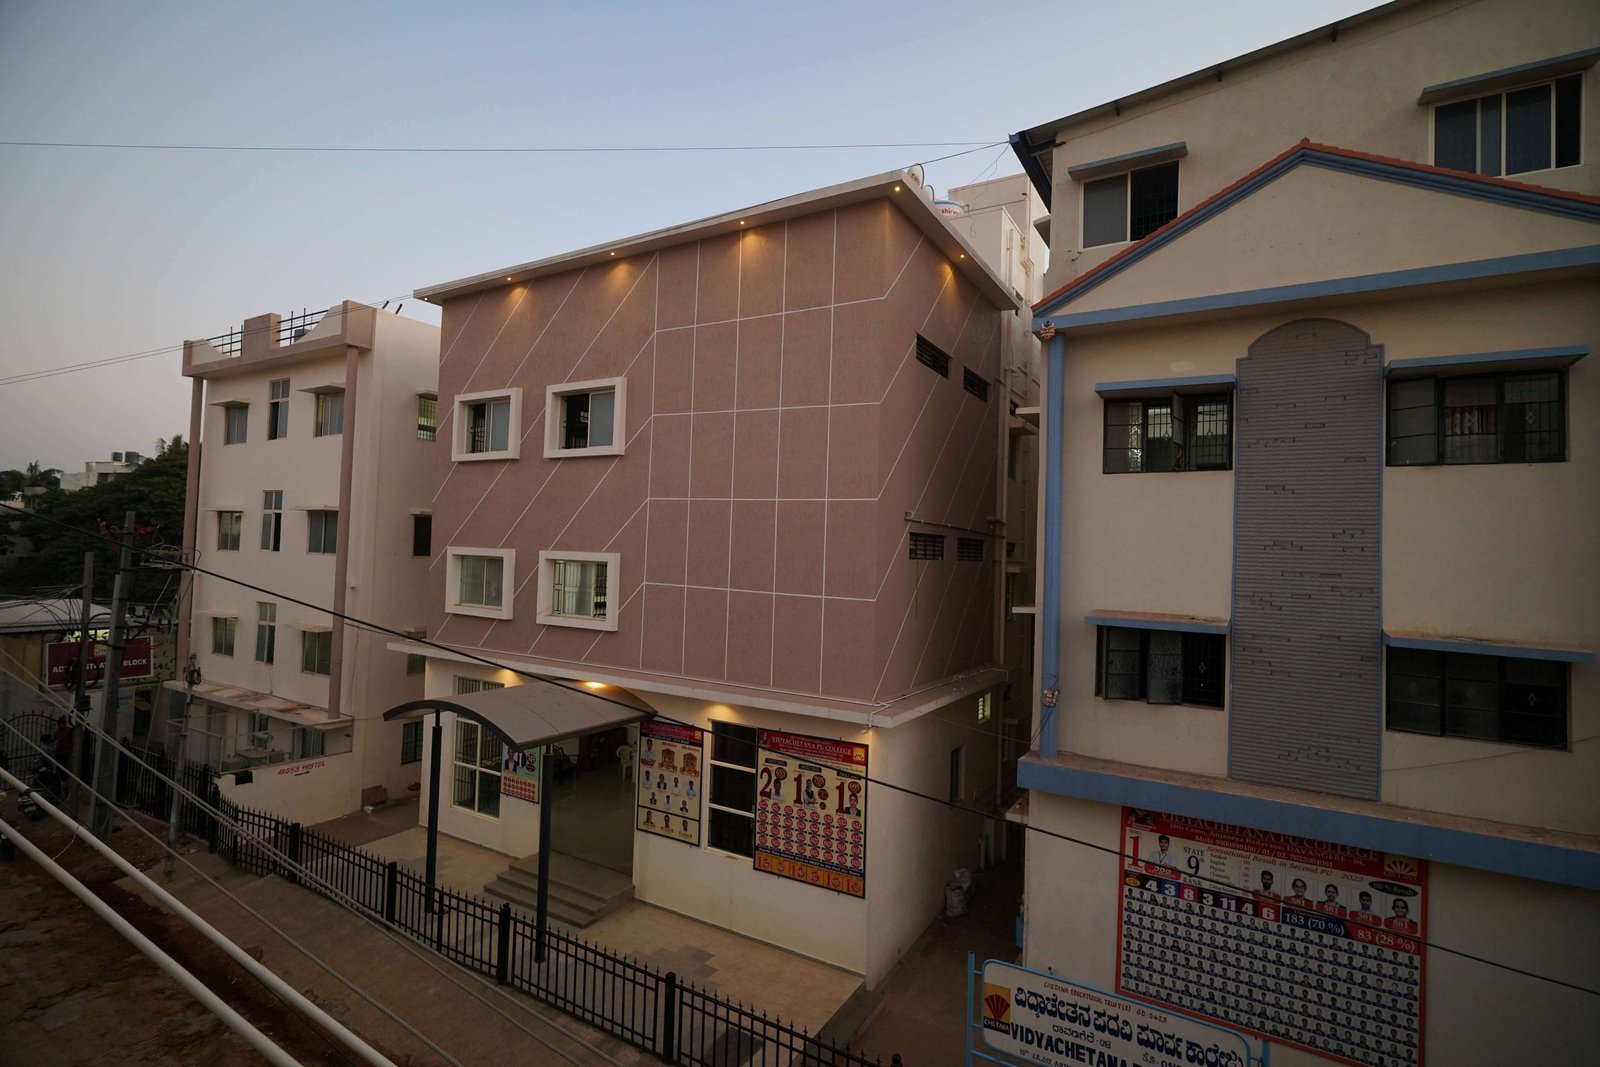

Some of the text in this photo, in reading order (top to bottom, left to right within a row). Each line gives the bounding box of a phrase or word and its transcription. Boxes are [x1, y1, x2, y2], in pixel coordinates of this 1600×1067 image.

[122, 658, 147, 667] BLOCK
[760, 767, 772, 799] 2
[793, 773, 803, 804] 1
[836, 782, 846, 814] 1
[1128, 835, 1142, 867] 1
[1183, 846, 1204, 857] STATE
[1206, 846, 1251, 860] Sensational
[1252, 854, 1277, 866] Result
[1288, 861, 1318, 874] Second
[1145, 879, 1158, 892] 4
[1164, 883, 1176, 896] 3
[1183, 888, 1194, 901] 8
[1202, 893, 1213, 905] 3
[1220, 897, 1236, 911] 11
[1242, 902, 1253, 915] 4
[1262, 907, 1275, 920] 6
[1284, 912, 1304, 925] 183
[1392, 920, 1408, 929] 581
[1357, 929, 1372, 940] 83
[1044, 981, 1069, 994] CHETANA
[984, 1017, 1010, 1033] CHETANA
[1014, 986, 1091, 1028] ವಿದ್ಯಾಚೇತನ
[1093, 1008, 1133, 1042] ಪದವಿ
[1136, 1023, 1184, 1060] ಪೂರ್ವ
